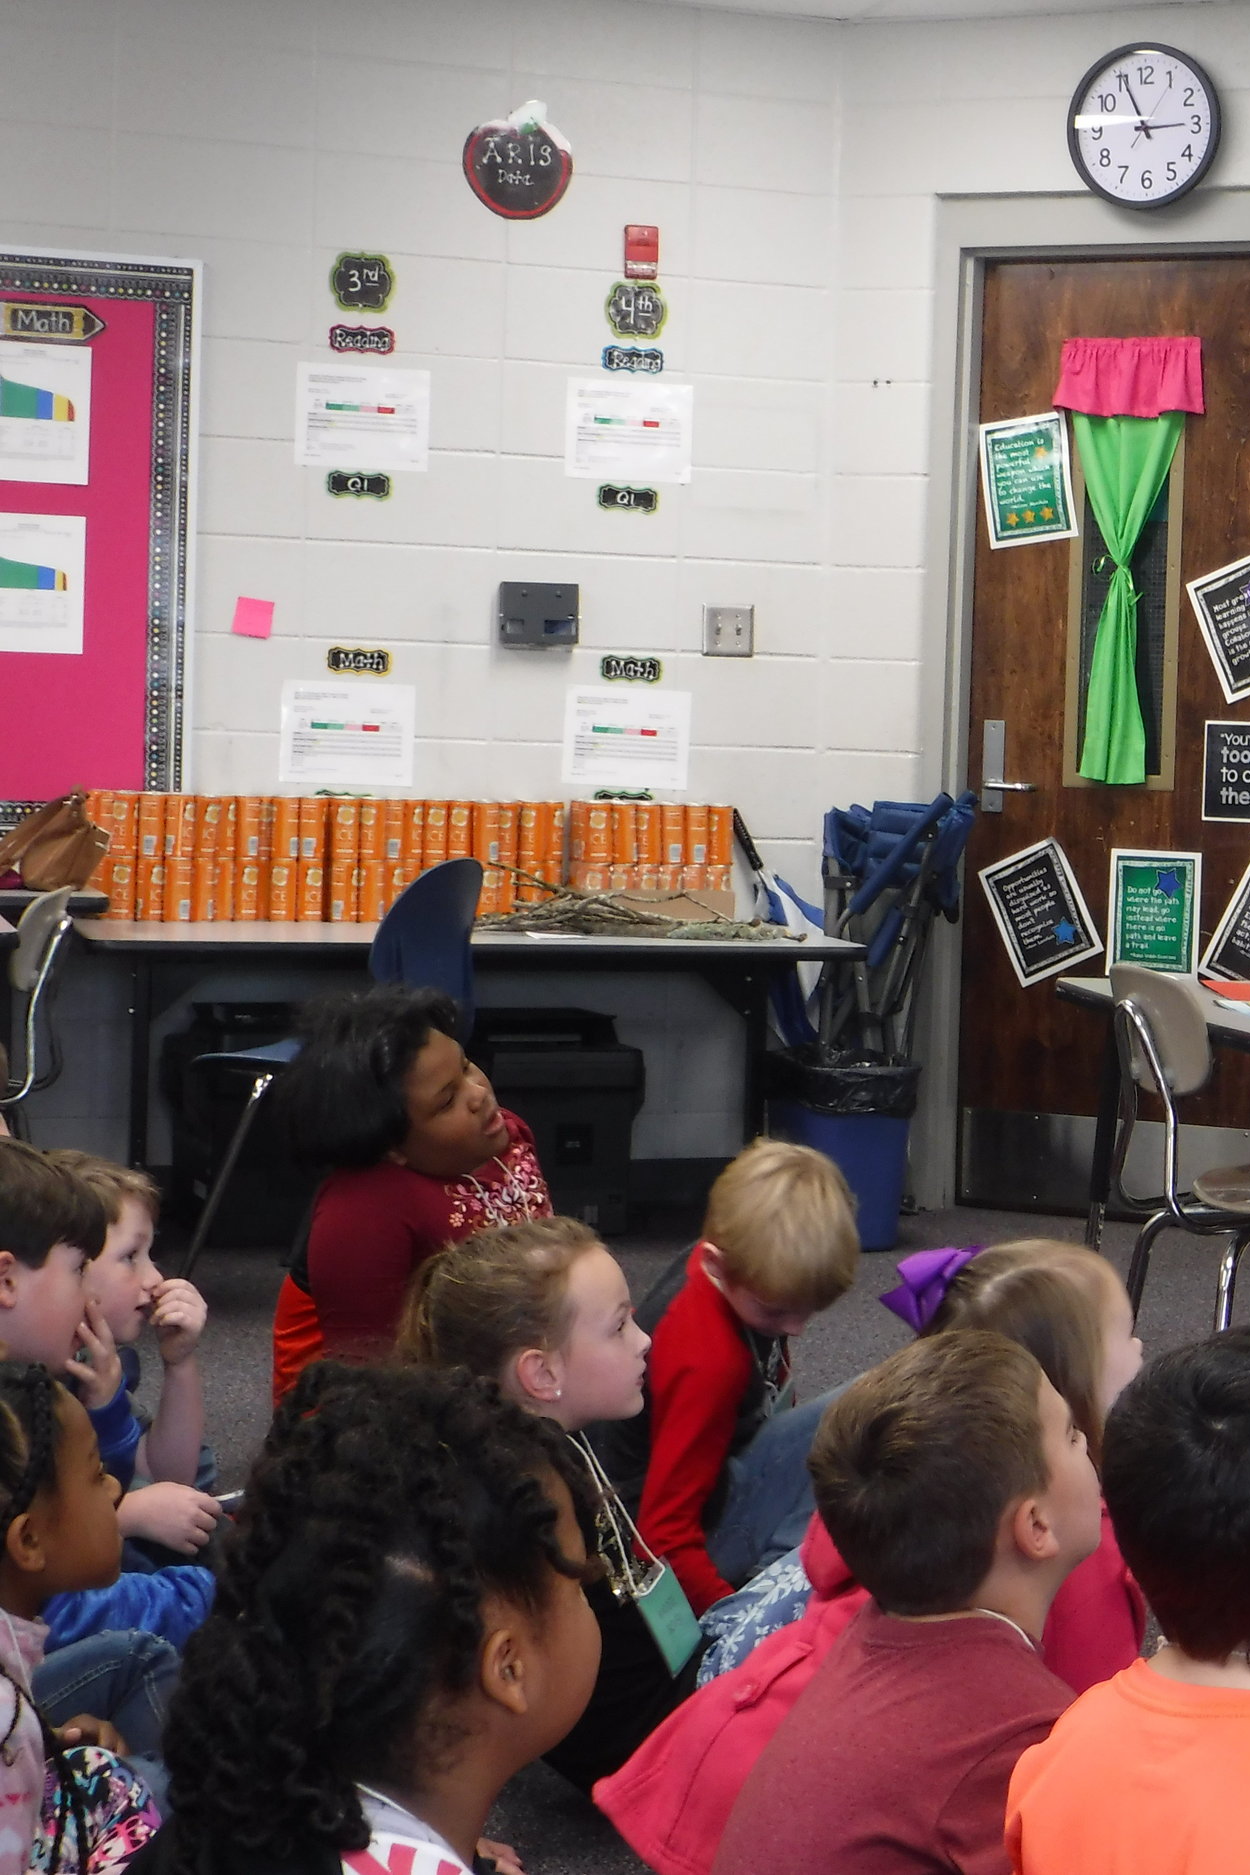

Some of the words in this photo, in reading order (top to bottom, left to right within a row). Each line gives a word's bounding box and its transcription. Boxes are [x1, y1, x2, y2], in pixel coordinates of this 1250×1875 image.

[1116, 74, 1130, 92] 11
[1137, 66, 1155, 85] 12
[1166, 70, 1173, 88] 1
[1098, 93, 1116, 112] 10
[1183, 88, 1194, 107] 2
[1091, 126, 1103, 140] 9
[1190, 115, 1202, 134] 3
[1099, 148, 1111, 167] 8
[1181, 144, 1194, 162] 4
[1118, 165, 1129, 184] 7
[1141, 170, 1152, 189] 6
[1166, 162, 1177, 181] 5
[621, 296, 653, 324] 4th
[17, 310, 71, 332] Math
[335, 329, 390, 351] Reading
[613, 350, 661, 372] Reading
[995, 441, 1034, 451] Education
[998, 480, 1011, 490] you
[1213, 599, 1230, 613] Most
[1231, 590, 1250, 606] great
[1215, 604, 1246, 621] learning
[1218, 612, 1247, 630] happens
[1228, 648, 1236, 656] is
[1236, 642, 1249, 652] the
[339, 652, 384, 669] Math
[611, 661, 654, 679] Math
[1221, 746, 1250, 764] too
[1220, 766, 1238, 782] to
[1220, 787, 1250, 805] the
[1003, 867, 1047, 893] Opportunities
[1006, 891, 1018, 899] are
[1019, 879, 1044, 893] usually
[1011, 900, 1028, 914] hard
[1030, 895, 1047, 906] work
[1126, 906, 1140, 914] may
[1164, 897, 1180, 905] path
[1015, 910, 1032, 922] most
[1034, 900, 1056, 917] people
[1126, 914, 1154, 922] instead
[1021, 919, 1054, 938] recognize
[1126, 932, 1141, 940] path
